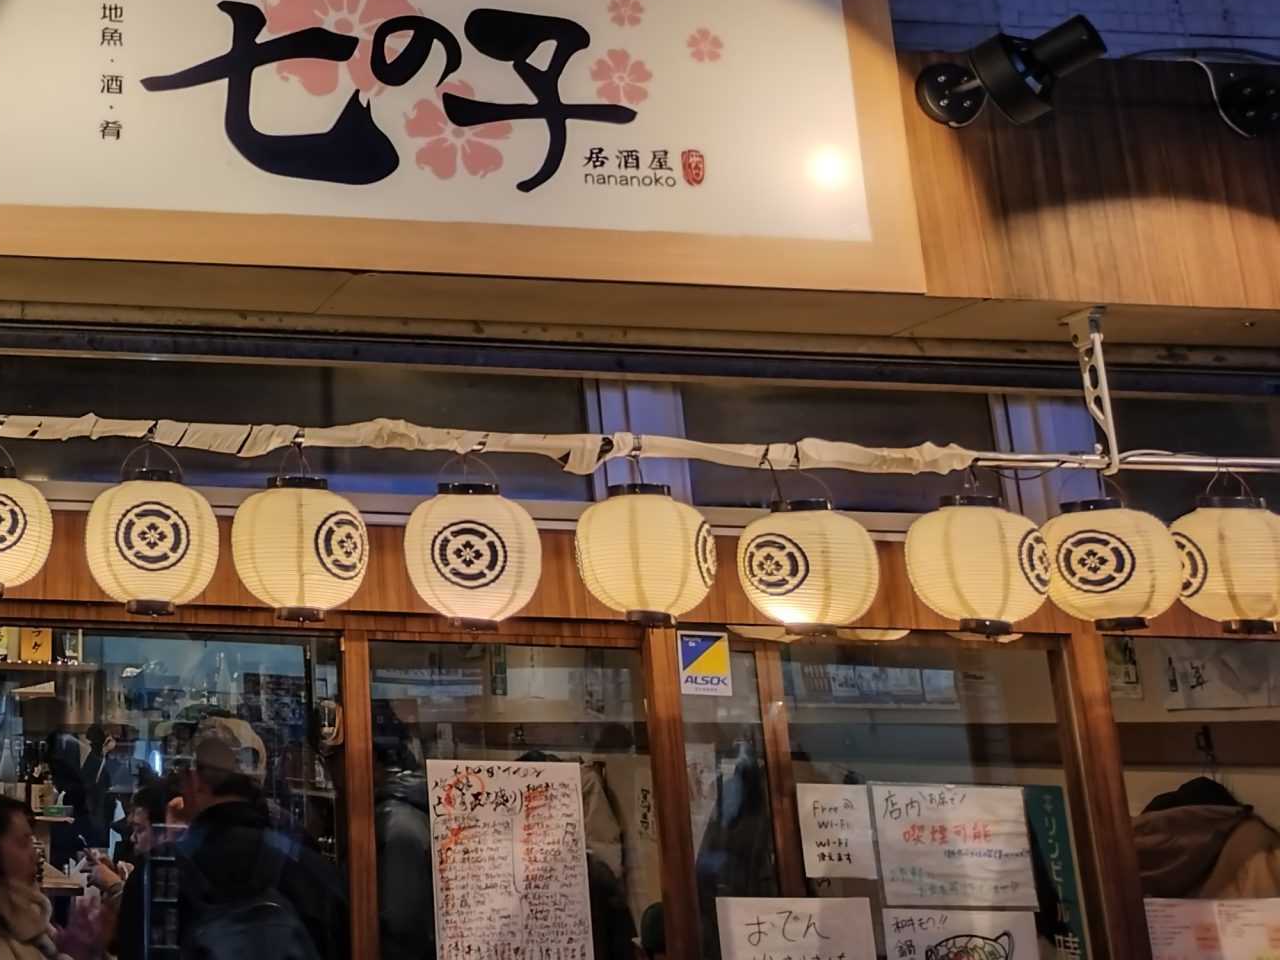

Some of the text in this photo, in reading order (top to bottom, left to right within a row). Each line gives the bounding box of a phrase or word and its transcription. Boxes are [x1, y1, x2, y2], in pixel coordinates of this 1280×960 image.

[138, 0, 637, 192] 七の子
[582, 146, 674, 172] 居酒屋
[583, 171, 677, 188] nananoko
[684, 675, 728, 686] ALSOK
[812, 800, 839, 818] Free
[882, 789, 922, 821] 店内
[902, 823, 993, 846] 喫煙可能
[1041, 793, 1071, 924] キリンビール
[744, 909, 831, 947] おでん
[894, 939, 917, 960] 鍋
